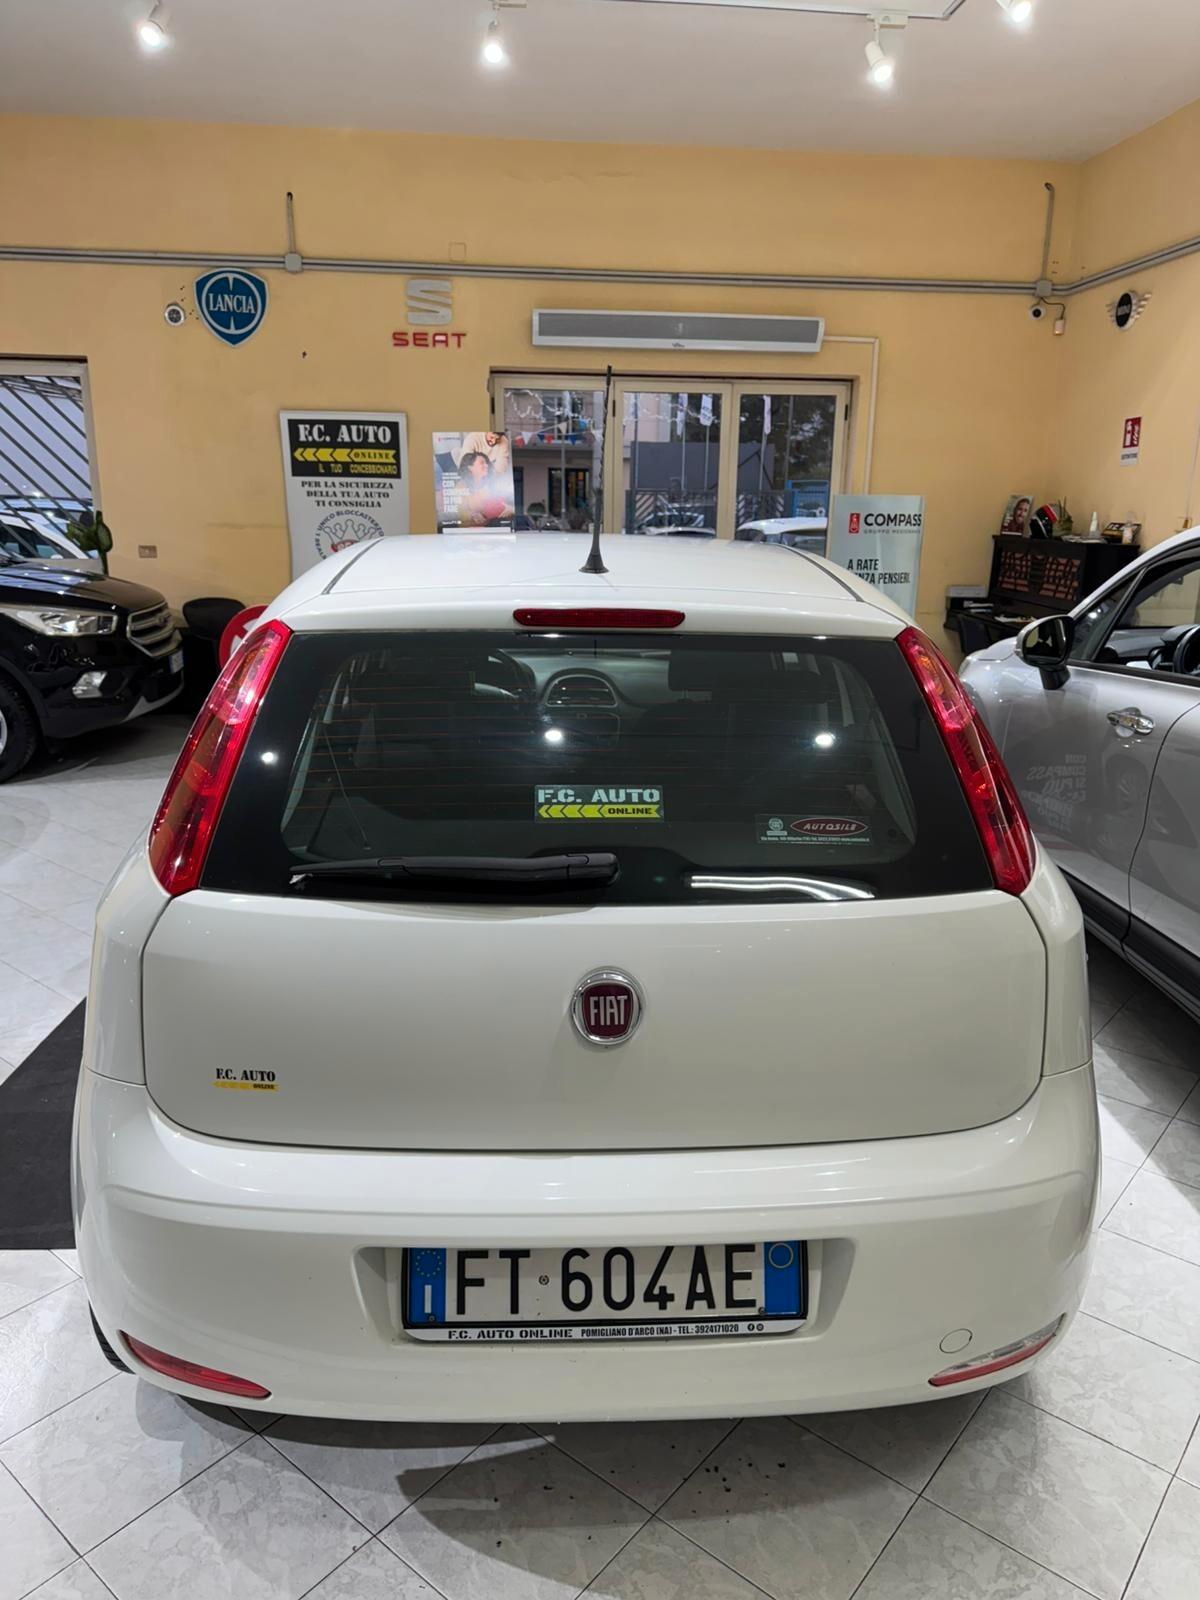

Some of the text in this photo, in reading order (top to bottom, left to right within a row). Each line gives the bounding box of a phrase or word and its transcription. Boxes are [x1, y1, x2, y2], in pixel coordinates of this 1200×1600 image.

[208, 293, 256, 314] LANCIA
[392, 332, 467, 348] SEAT
[298, 424, 392, 443] F.C. AUTO
[354, 452, 390, 460] ONLINE
[330, 463, 343, 473] TUO
[339, 482, 394, 490] SICUREZZA
[340, 491, 360, 499] TUA
[315, 500, 382, 509] TI CONSIGLIA
[864, 513, 922, 527] COMPASS
[847, 559, 879, 571] A RATE
[538, 788, 660, 803] F.C. AUTO
[608, 807, 653, 815] ONLINE
[803, 823, 857, 831] AUTOSILE
[589, 995, 628, 1026] FIAT
[216, 1068, 276, 1082] F.C. AUTO
[456, 1244, 757, 1316] FT 604AE
[448, 1330, 472, 1339] F.C.
[477, 1330, 514, 1339] AUTO
[519, 1329, 573, 1338] ONLINE
[581, 1327, 627, 1338] POMIGLIANO
[628, 1327, 655, 1337] D'ARCO
[656, 1326, 672, 1336] (NA)
[694, 1323, 739, 1334] 3924171020
